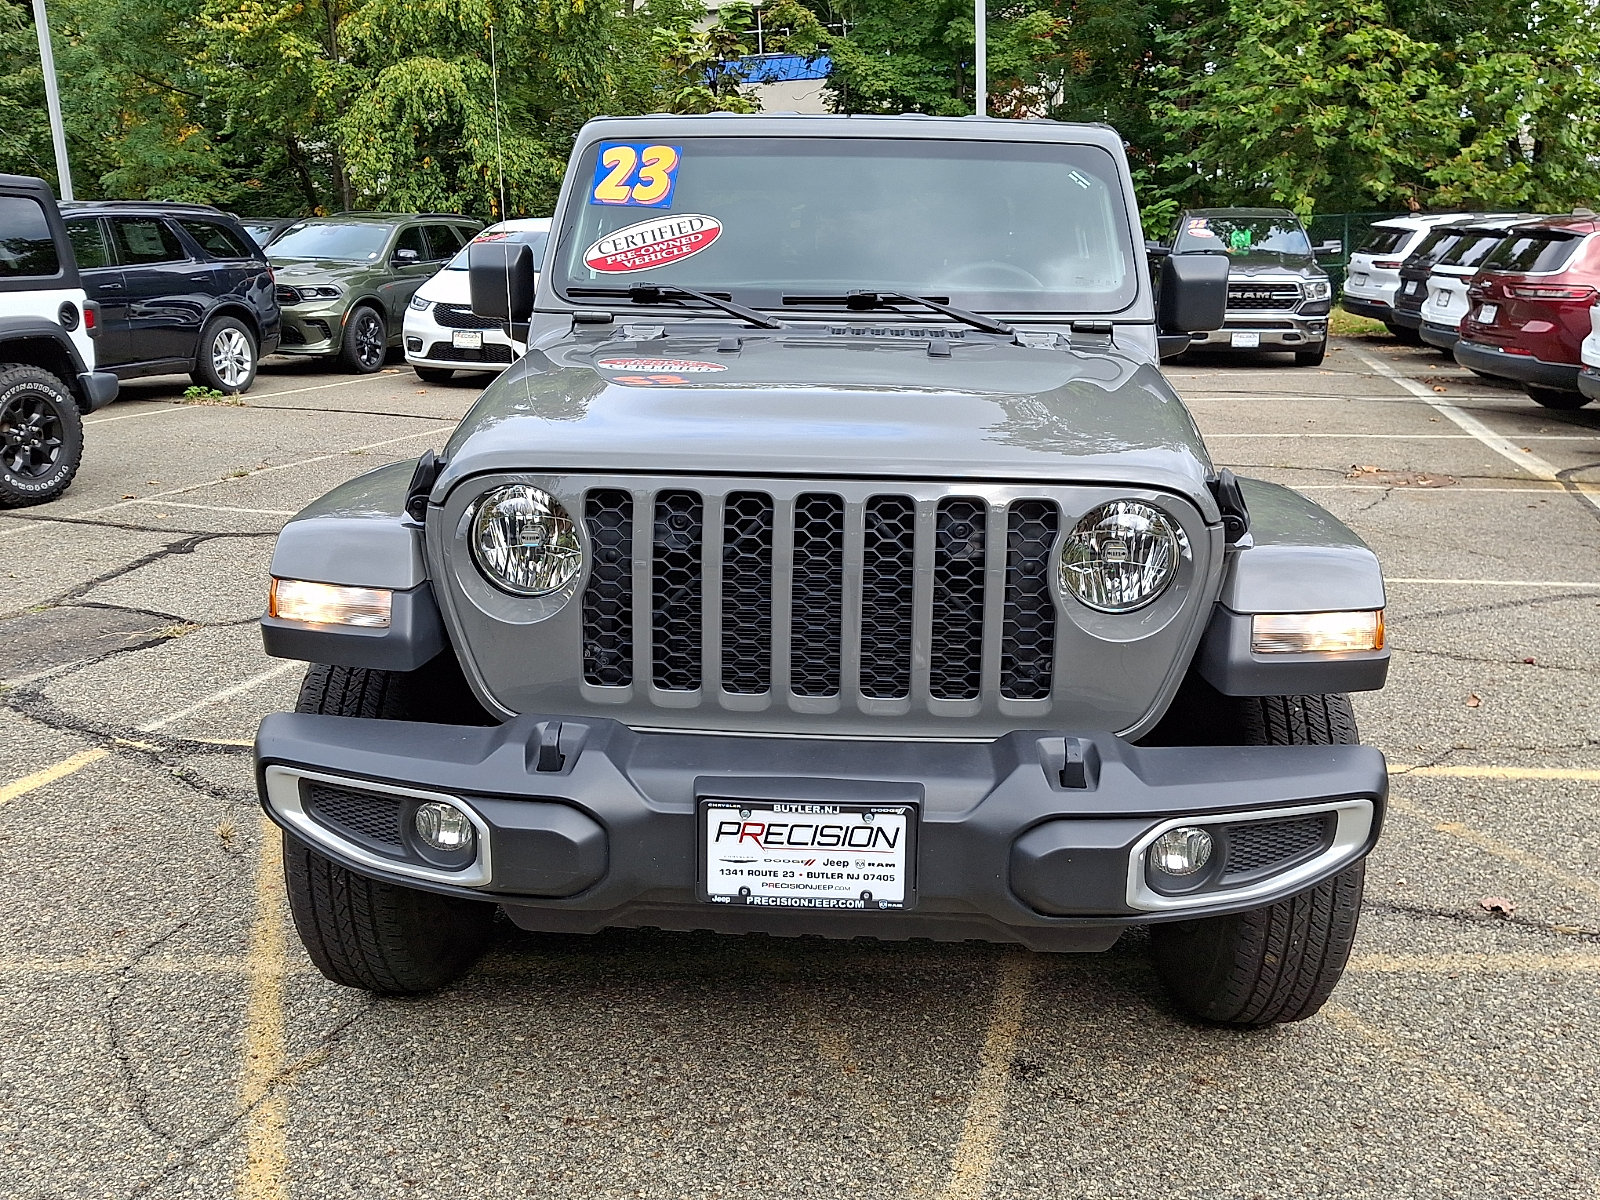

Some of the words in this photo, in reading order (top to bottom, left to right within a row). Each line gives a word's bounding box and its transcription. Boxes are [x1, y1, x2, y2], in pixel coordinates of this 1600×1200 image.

[594, 145, 679, 204] 23
[598, 217, 704, 255] CERTIFIED
[606, 233, 703, 265] PRE-OWNED
[621, 244, 692, 268] VEHICLE
[1229, 291, 1270, 299] RAM
[0, 382, 57, 408] ESTINATION
[715, 821, 900, 851] PRECISION
[823, 858, 849, 869] Jeep
[719, 868, 744, 876] 1341
[747, 869, 779, 877] ROUTE
[782, 870, 795, 878] 23
[806, 871, 844, 880] BUTLER
[863, 873, 896, 882] 07405
[761, 881, 851, 891] PRECISIONJEEP.COM
[711, 894, 731, 904] Jeep
[746, 896, 865, 909] PRECISIONJEEP.COM
